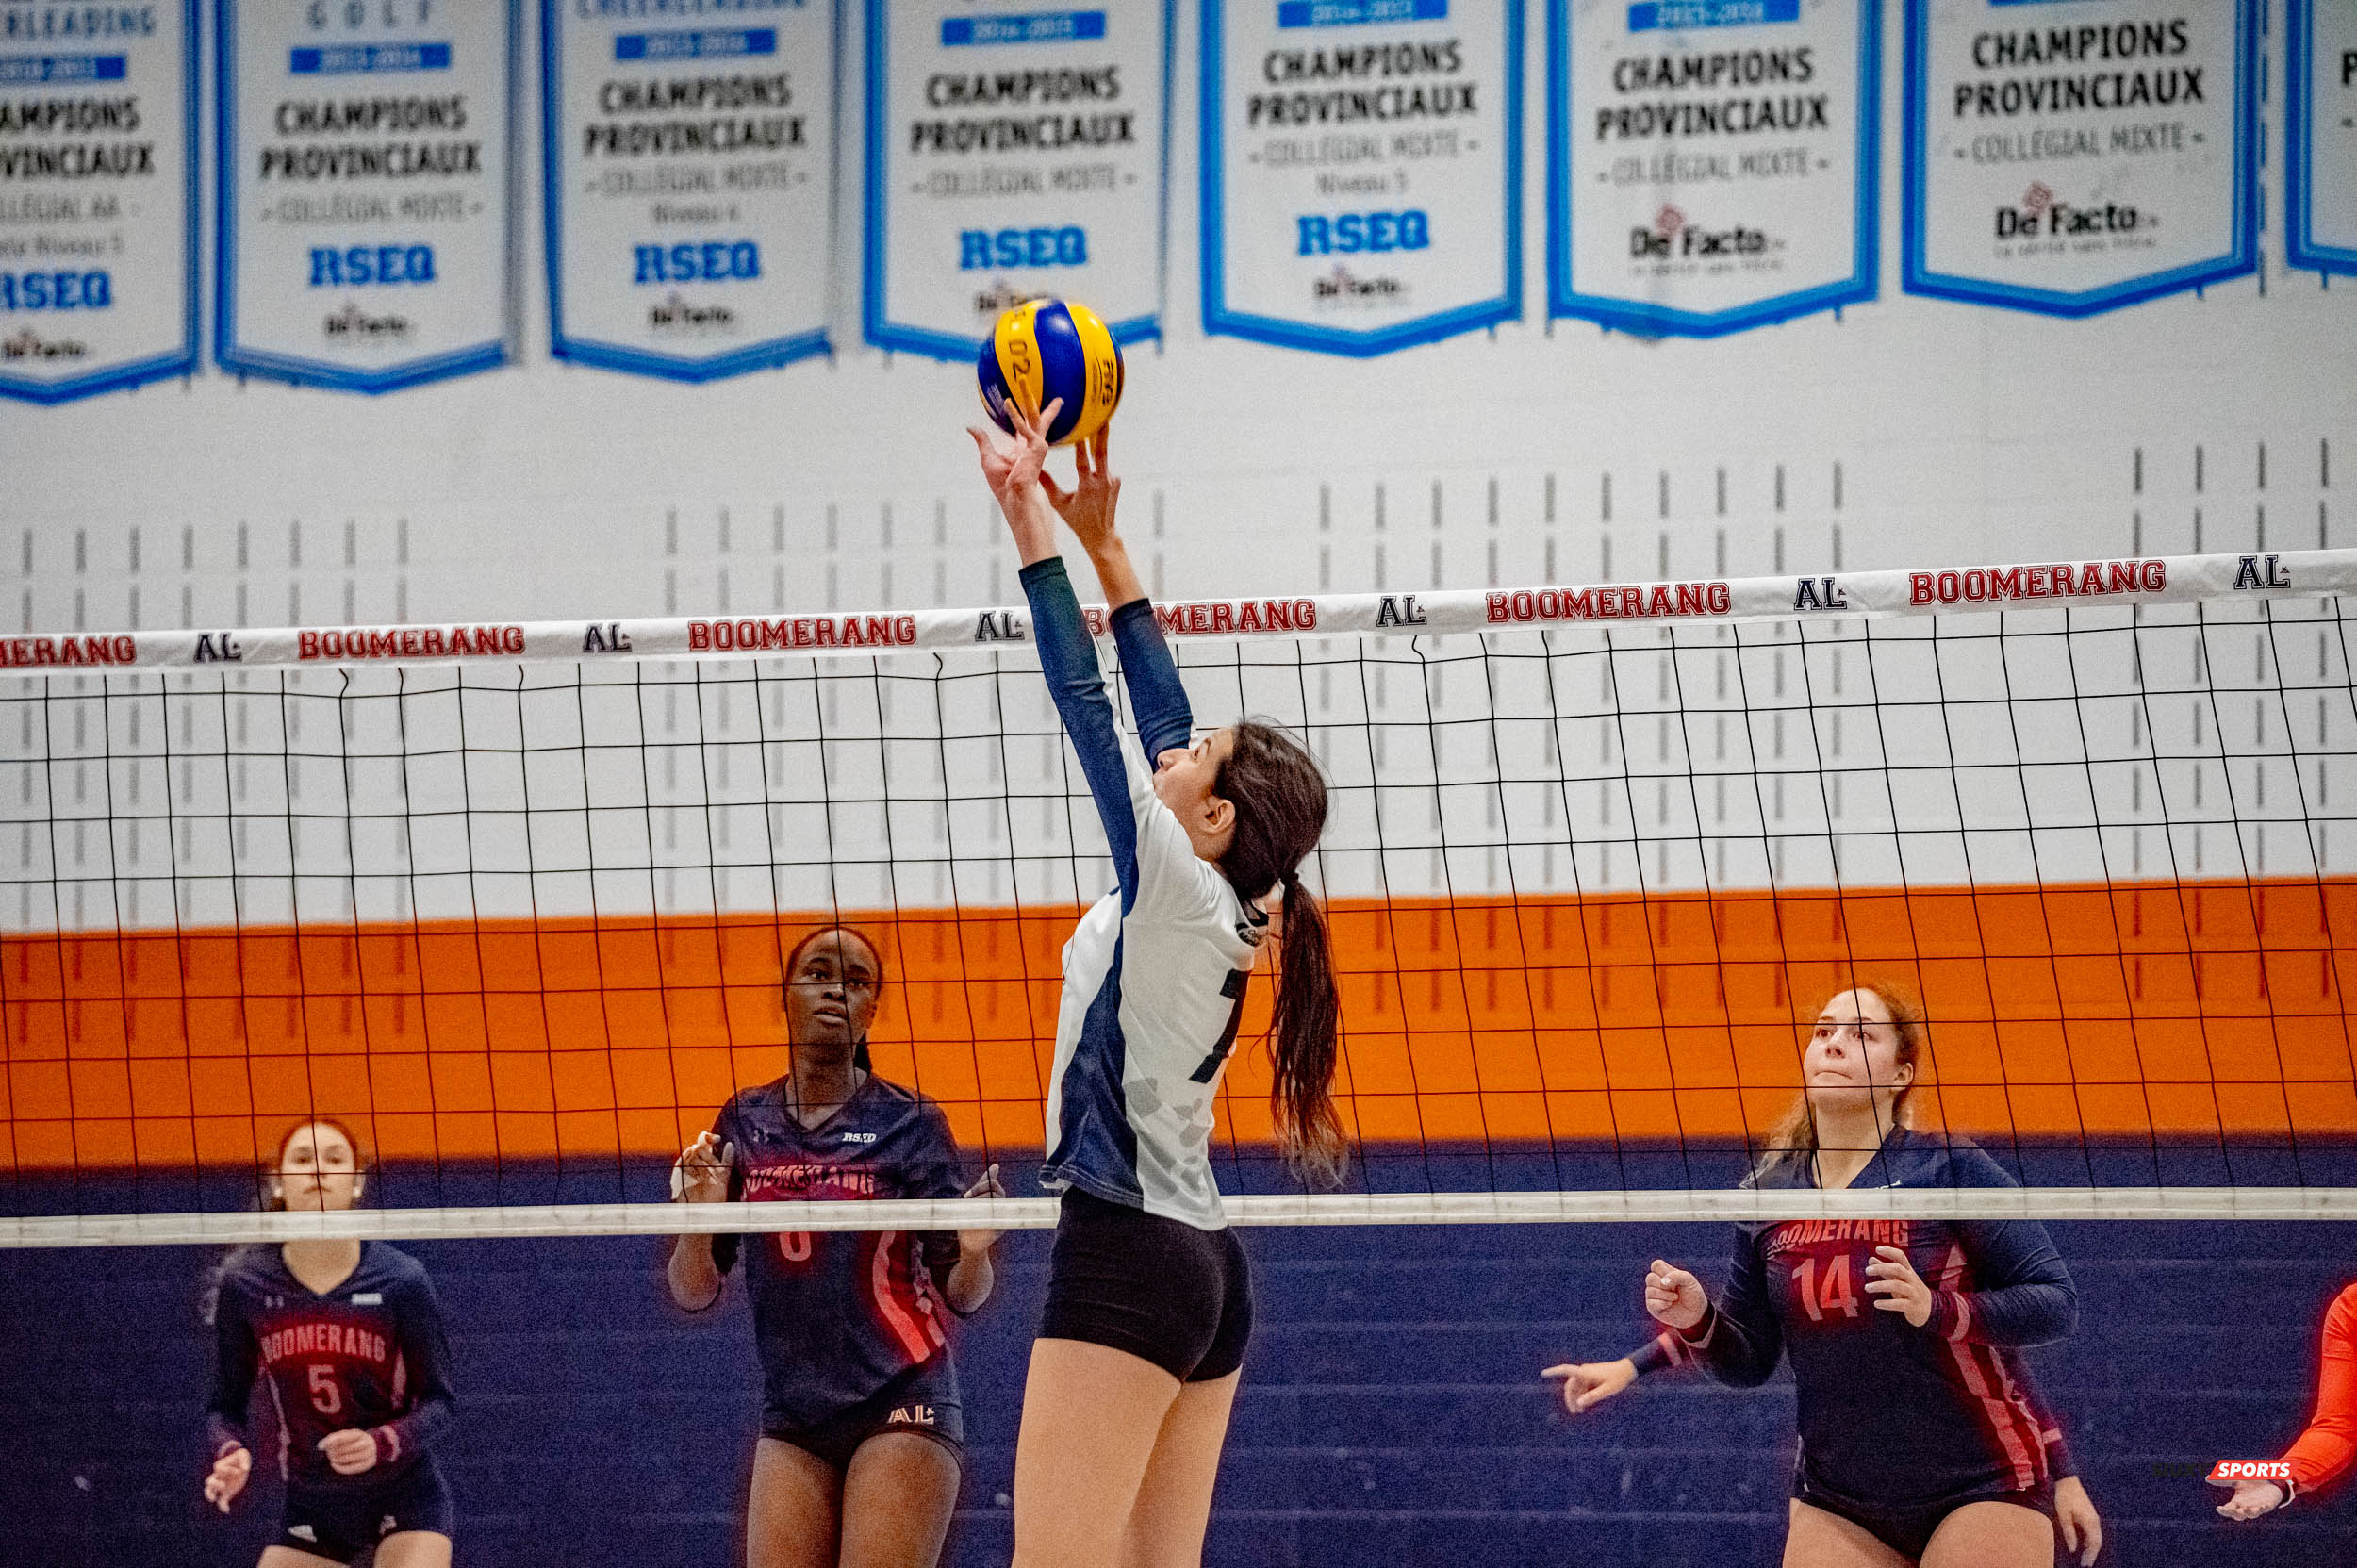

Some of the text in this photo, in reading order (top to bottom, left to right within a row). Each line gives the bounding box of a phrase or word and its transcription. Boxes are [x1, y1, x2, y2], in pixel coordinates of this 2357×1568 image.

[1263, 38, 1461, 86] CHAMPIONS
[1973, 18, 2188, 69] CHAMPIONS
[926, 64, 1120, 108] CHAMPIONS
[1613, 45, 1813, 93] CHAMPIONS
[275, 94, 467, 135] CHAMPIONS
[599, 71, 792, 115] CHAMPIONS
[1247, 81, 1478, 129] PROVINCIAUX
[1953, 66, 2204, 119] PROVINCIAUX
[584, 115, 807, 158] PROVINCIAUX
[910, 109, 1135, 155] PROVINCIAUX
[1596, 93, 1829, 140] PROVINCIAUX
[259, 141, 483, 181] PROVINCIAUX
[1297, 211, 1430, 256] RSEQ
[1630, 224, 1768, 260] De Facto
[1996, 206, 2038, 238] De
[2050, 202, 2137, 235] Facto
[311, 245, 435, 287] RSEQ
[635, 241, 762, 284] RSEQ
[960, 226, 1087, 271] RSEQ
[192, 633, 241, 663] AL
[298, 625, 526, 660] BOOMERANG
[582, 623, 632, 652] AL
[688, 615, 916, 652] BOOMERANG
[975, 611, 1025, 641] AL
[1083, 599, 1317, 637] BMERANG
[1376, 595, 1427, 627] AL
[1485, 582, 1732, 623] BOOMERANG
[1794, 578, 1847, 611] AL
[1909, 560, 2167, 606] BOOMERANG
[2234, 554, 2291, 590] AL
[1792, 1254, 1858, 1321] 14
[260, 1322, 386, 1364] BOOMERANG
[308, 1363, 341, 1414] 5
